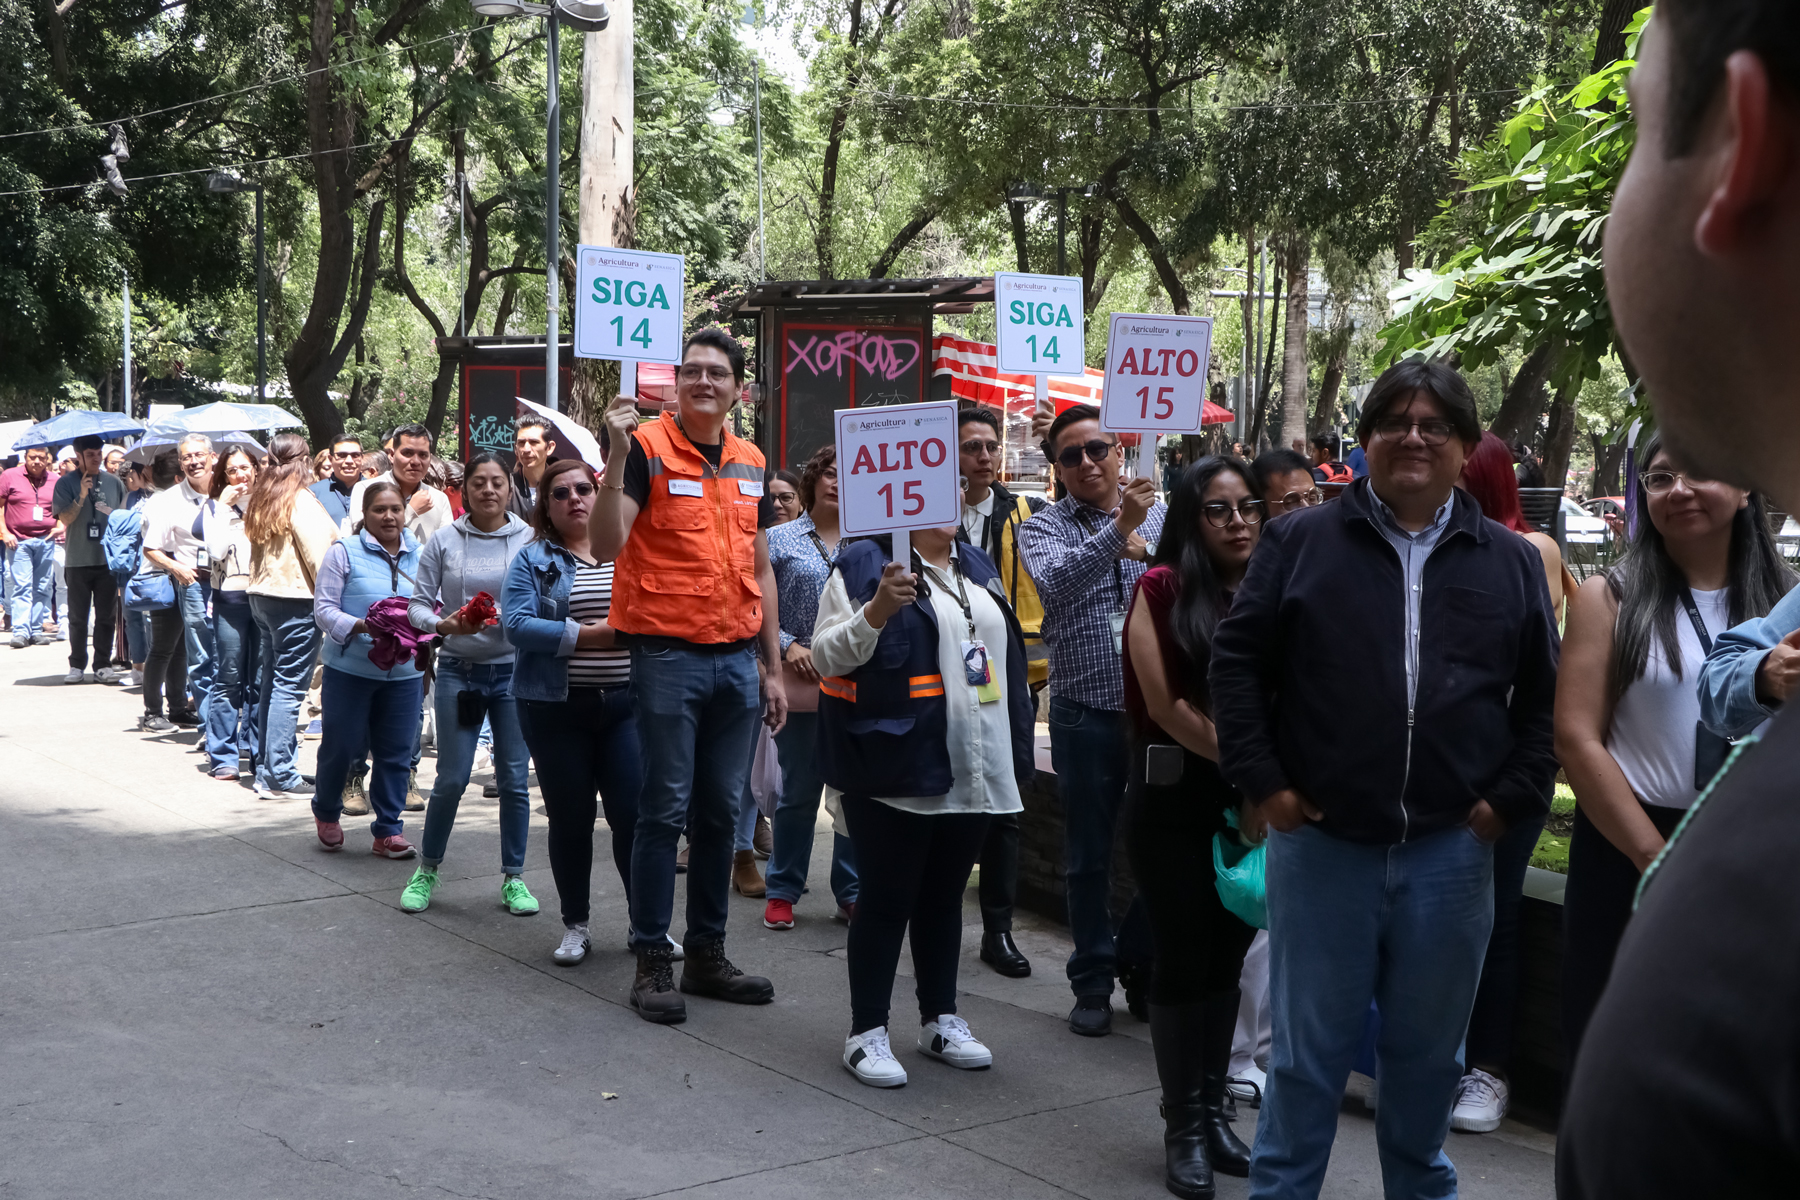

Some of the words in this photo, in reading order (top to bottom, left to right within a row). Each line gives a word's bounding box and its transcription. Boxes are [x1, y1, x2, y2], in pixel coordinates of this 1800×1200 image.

[598, 257, 639, 267] Agricultura
[592, 277, 671, 310] SIGA
[1013, 282, 1047, 290] Agricultura
[1009, 300, 1074, 328] SIGA
[610, 315, 653, 349] 14
[1130, 325, 1170, 334] Agricultura
[1025, 334, 1061, 364] 14
[1117, 347, 1199, 378] ALTO
[1135, 386, 1175, 420] 15
[859, 418, 906, 430] Agricultura
[850, 437, 947, 475] ALTO
[877, 480, 926, 518] 15
